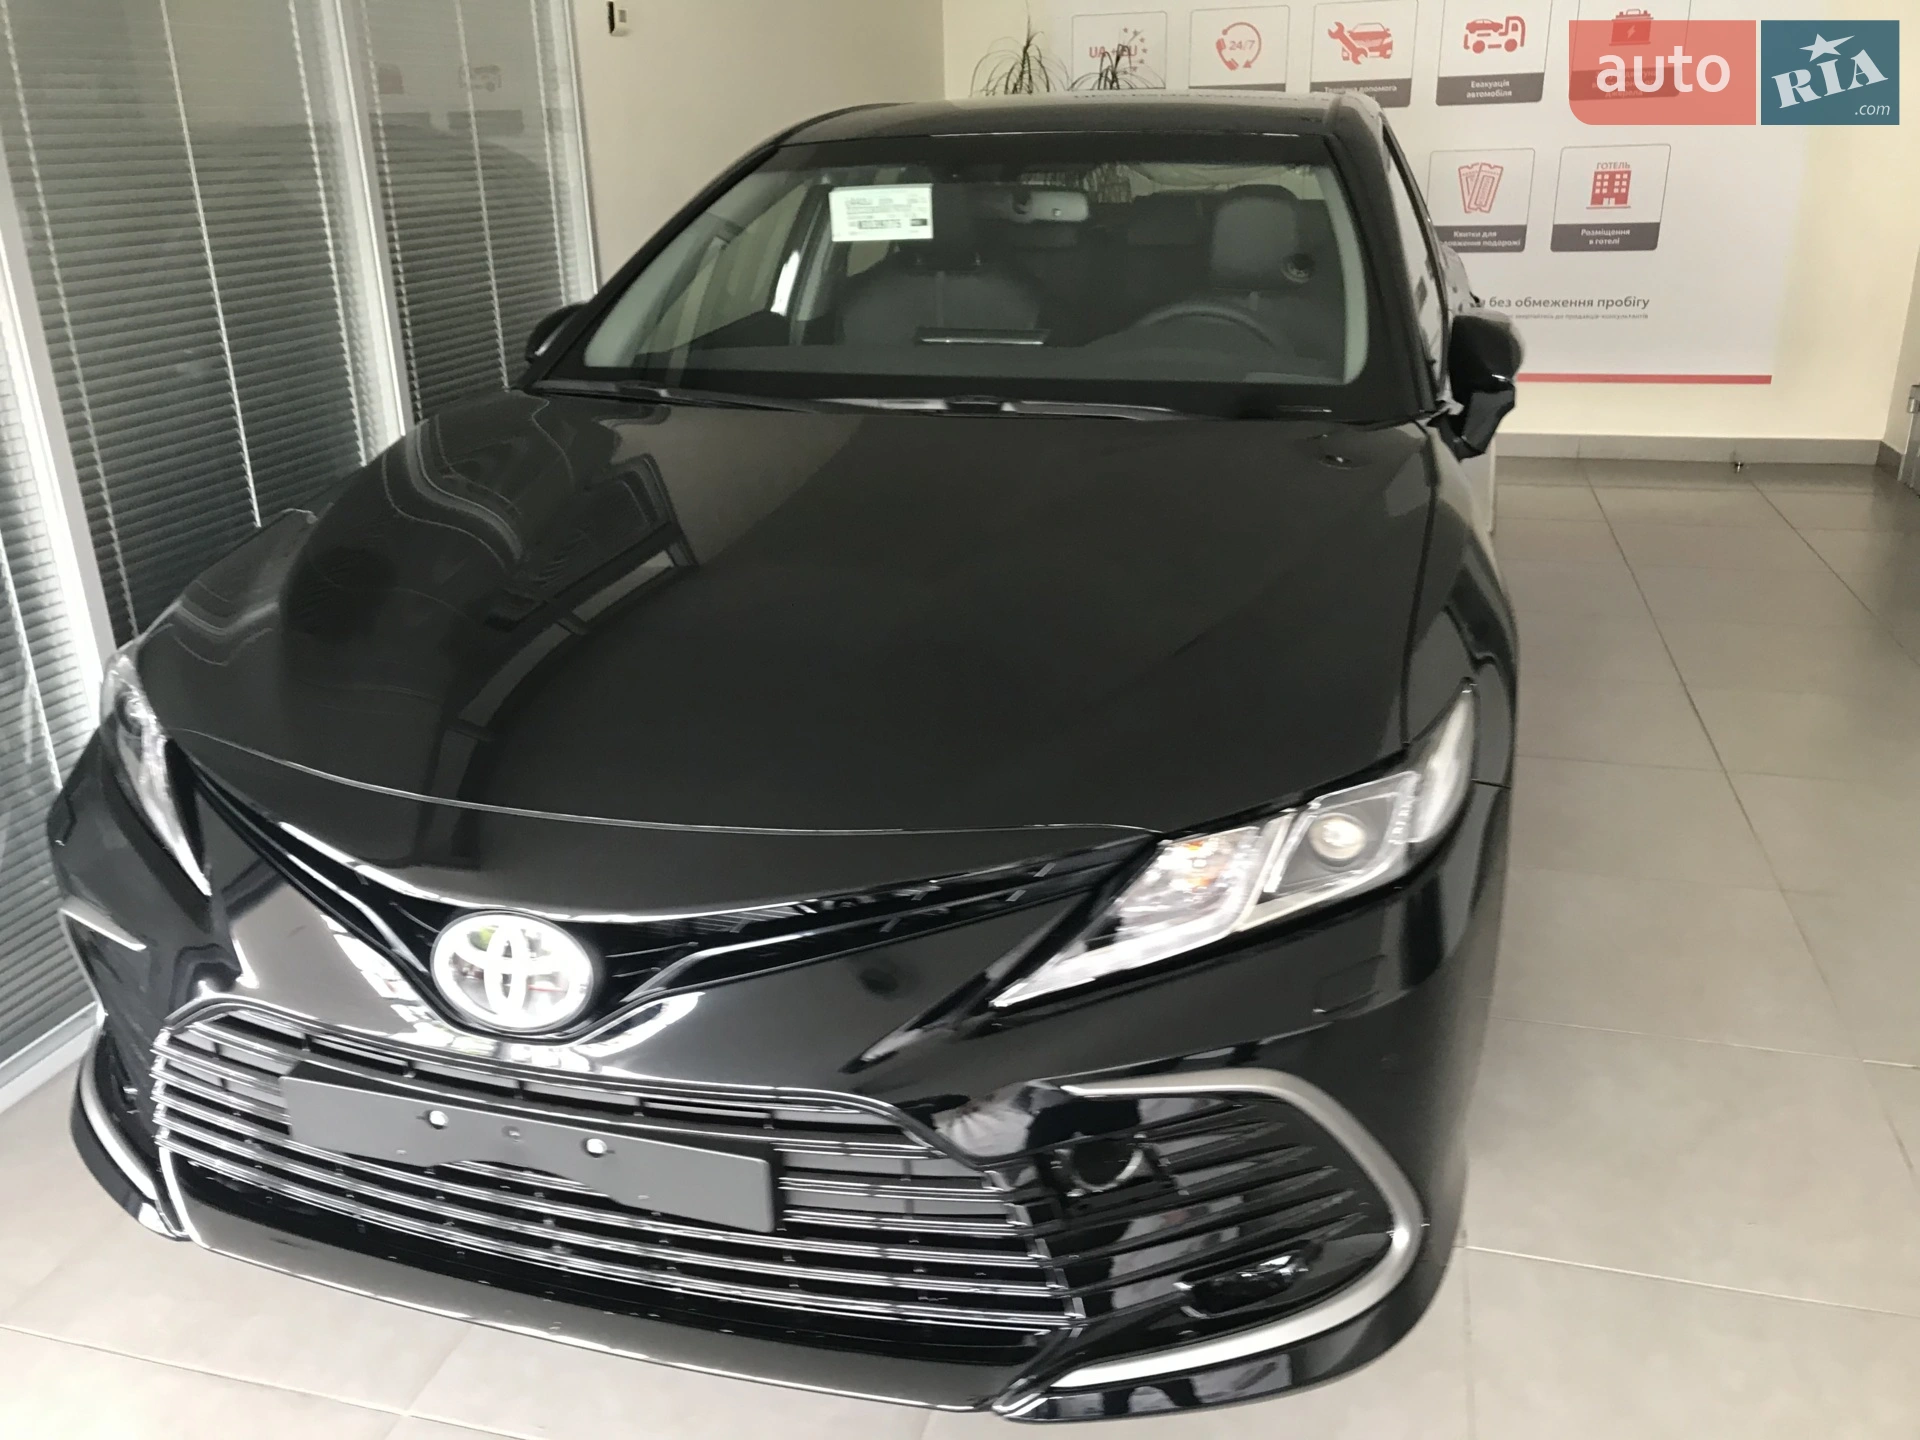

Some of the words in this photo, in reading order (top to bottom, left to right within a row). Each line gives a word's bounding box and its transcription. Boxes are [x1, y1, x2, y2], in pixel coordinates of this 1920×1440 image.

[1229, 40, 1256, 51] 24/7
[1596, 162, 1631, 170] ГОТЕЛЬ
[1581, 228, 1631, 237] Розміщення
[1595, 237, 1620, 245] готелі
[1489, 296, 1512, 308] без
[1515, 297, 1594, 308] обмеження
[1597, 296, 1650, 310] пробігу
